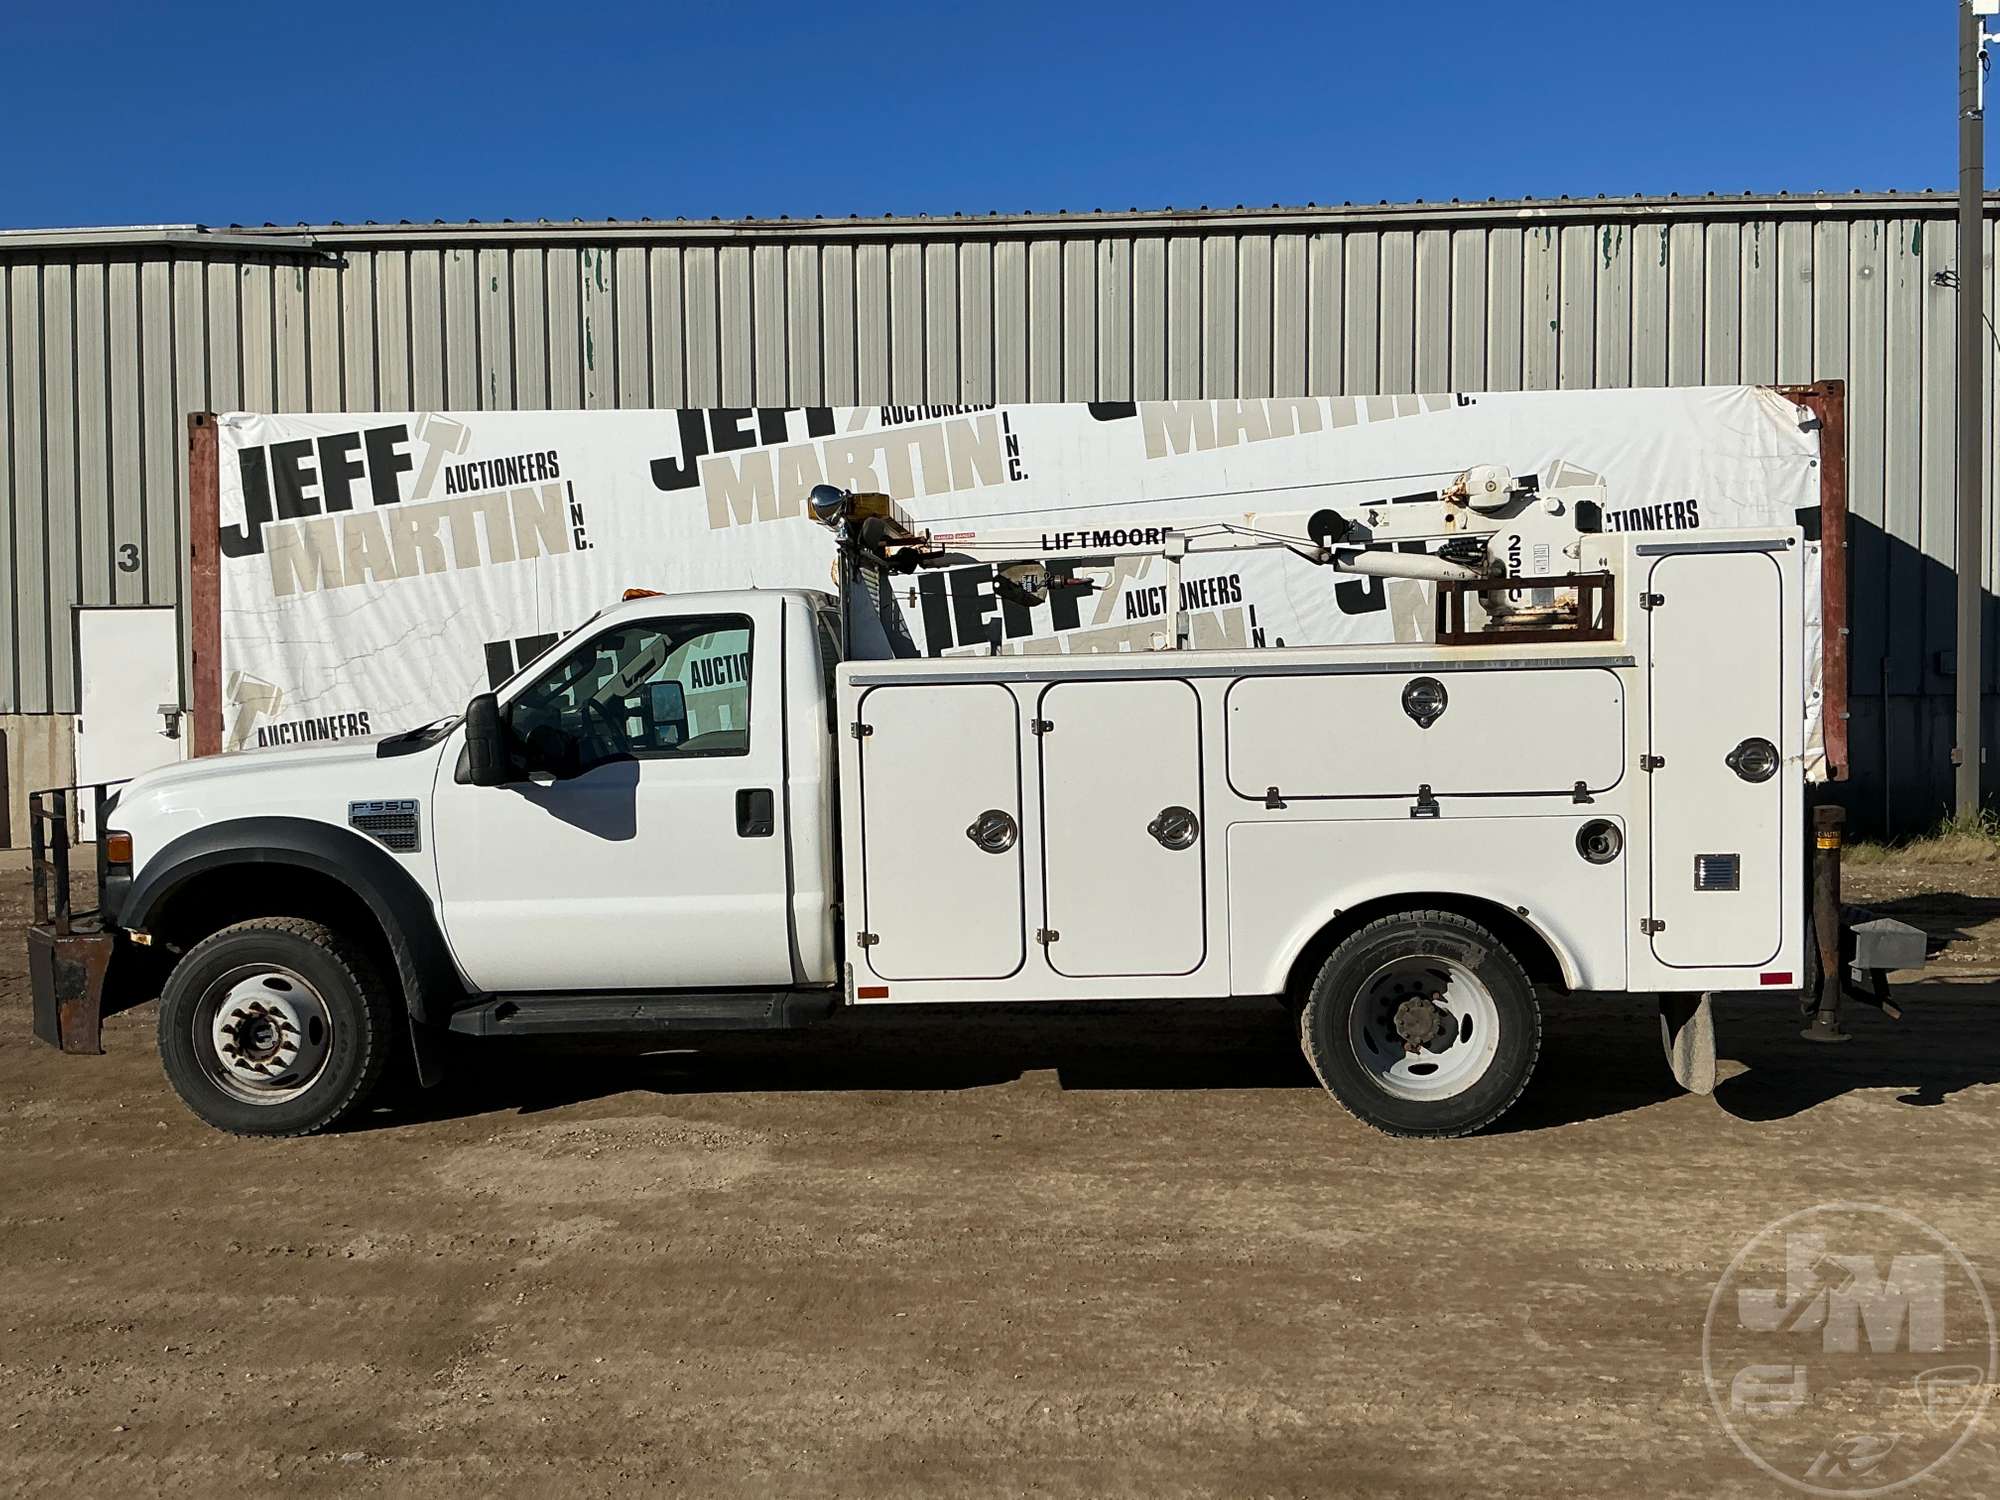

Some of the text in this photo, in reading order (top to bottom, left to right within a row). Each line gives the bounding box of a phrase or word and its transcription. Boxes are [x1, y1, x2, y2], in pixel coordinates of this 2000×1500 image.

[219, 423, 414, 559] JEFF
[445, 449, 560, 495] AUCTIONEERS
[118, 543, 141, 573] 3
[264, 482, 571, 598] MARTIN
